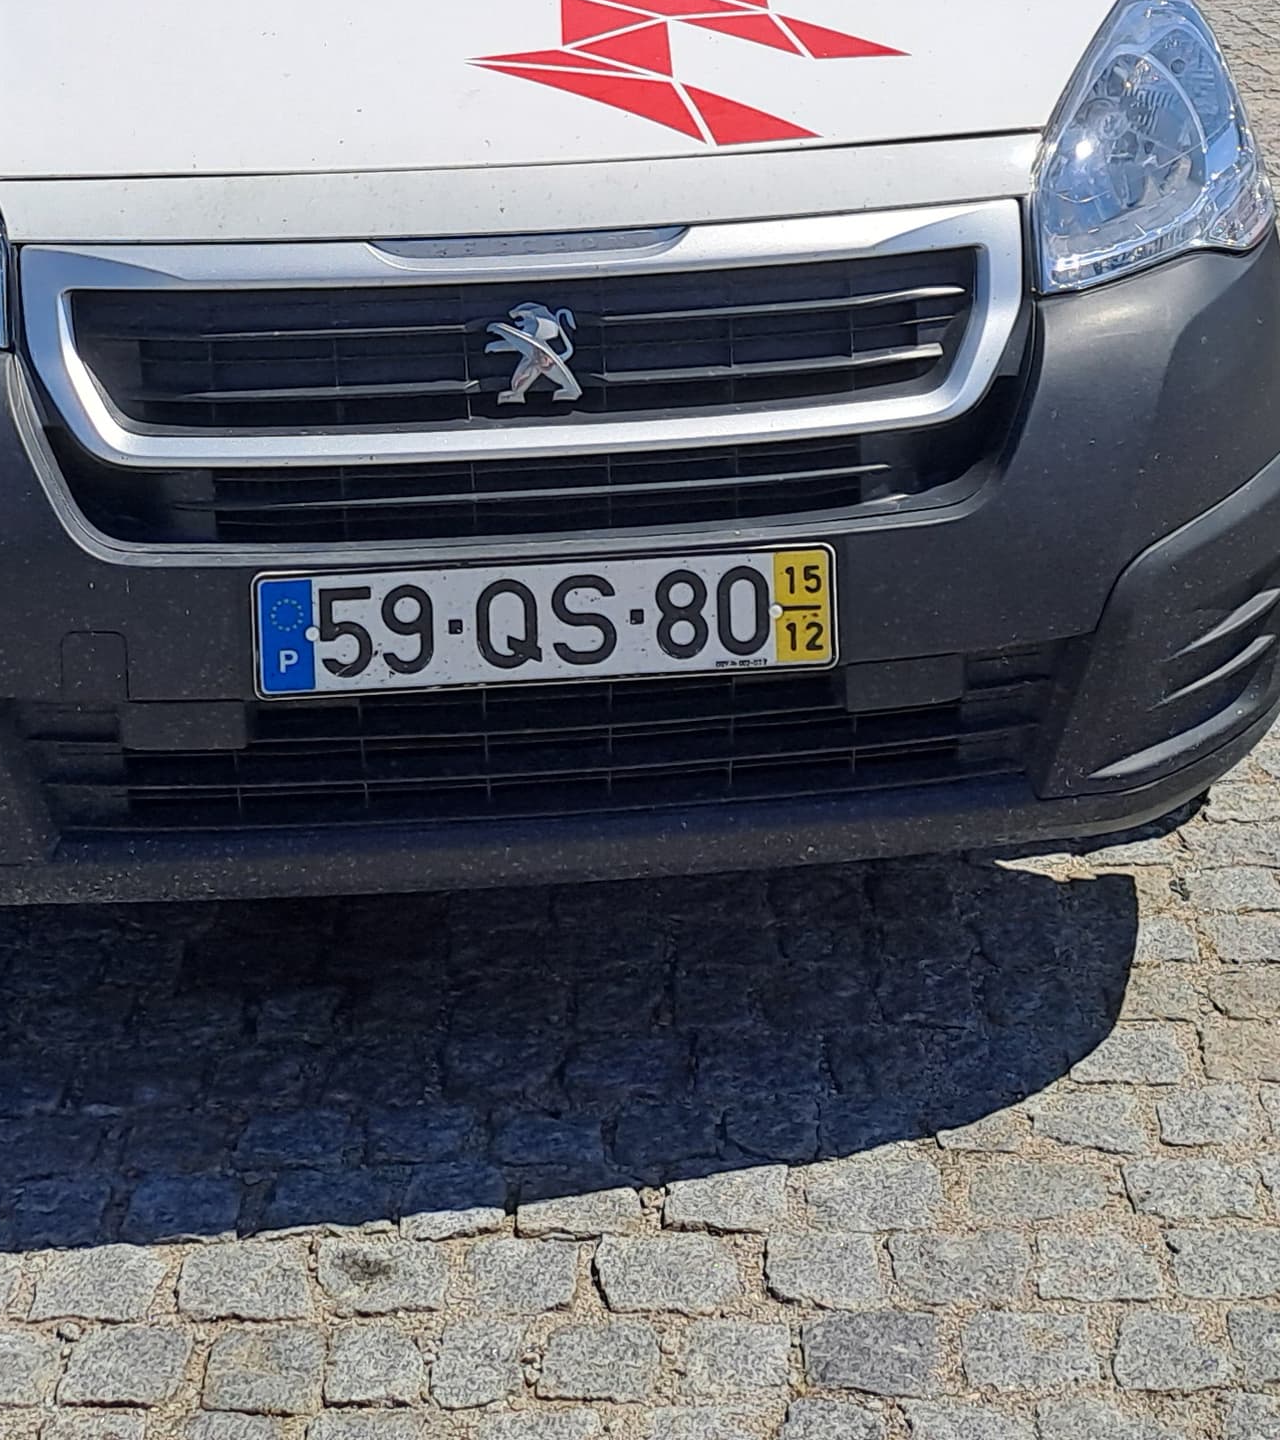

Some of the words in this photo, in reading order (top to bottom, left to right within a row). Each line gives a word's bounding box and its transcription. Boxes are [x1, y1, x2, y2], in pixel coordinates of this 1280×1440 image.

[785, 565, 822, 594] 15
[786, 622, 824, 651] 12
[279, 649, 299, 674] P
